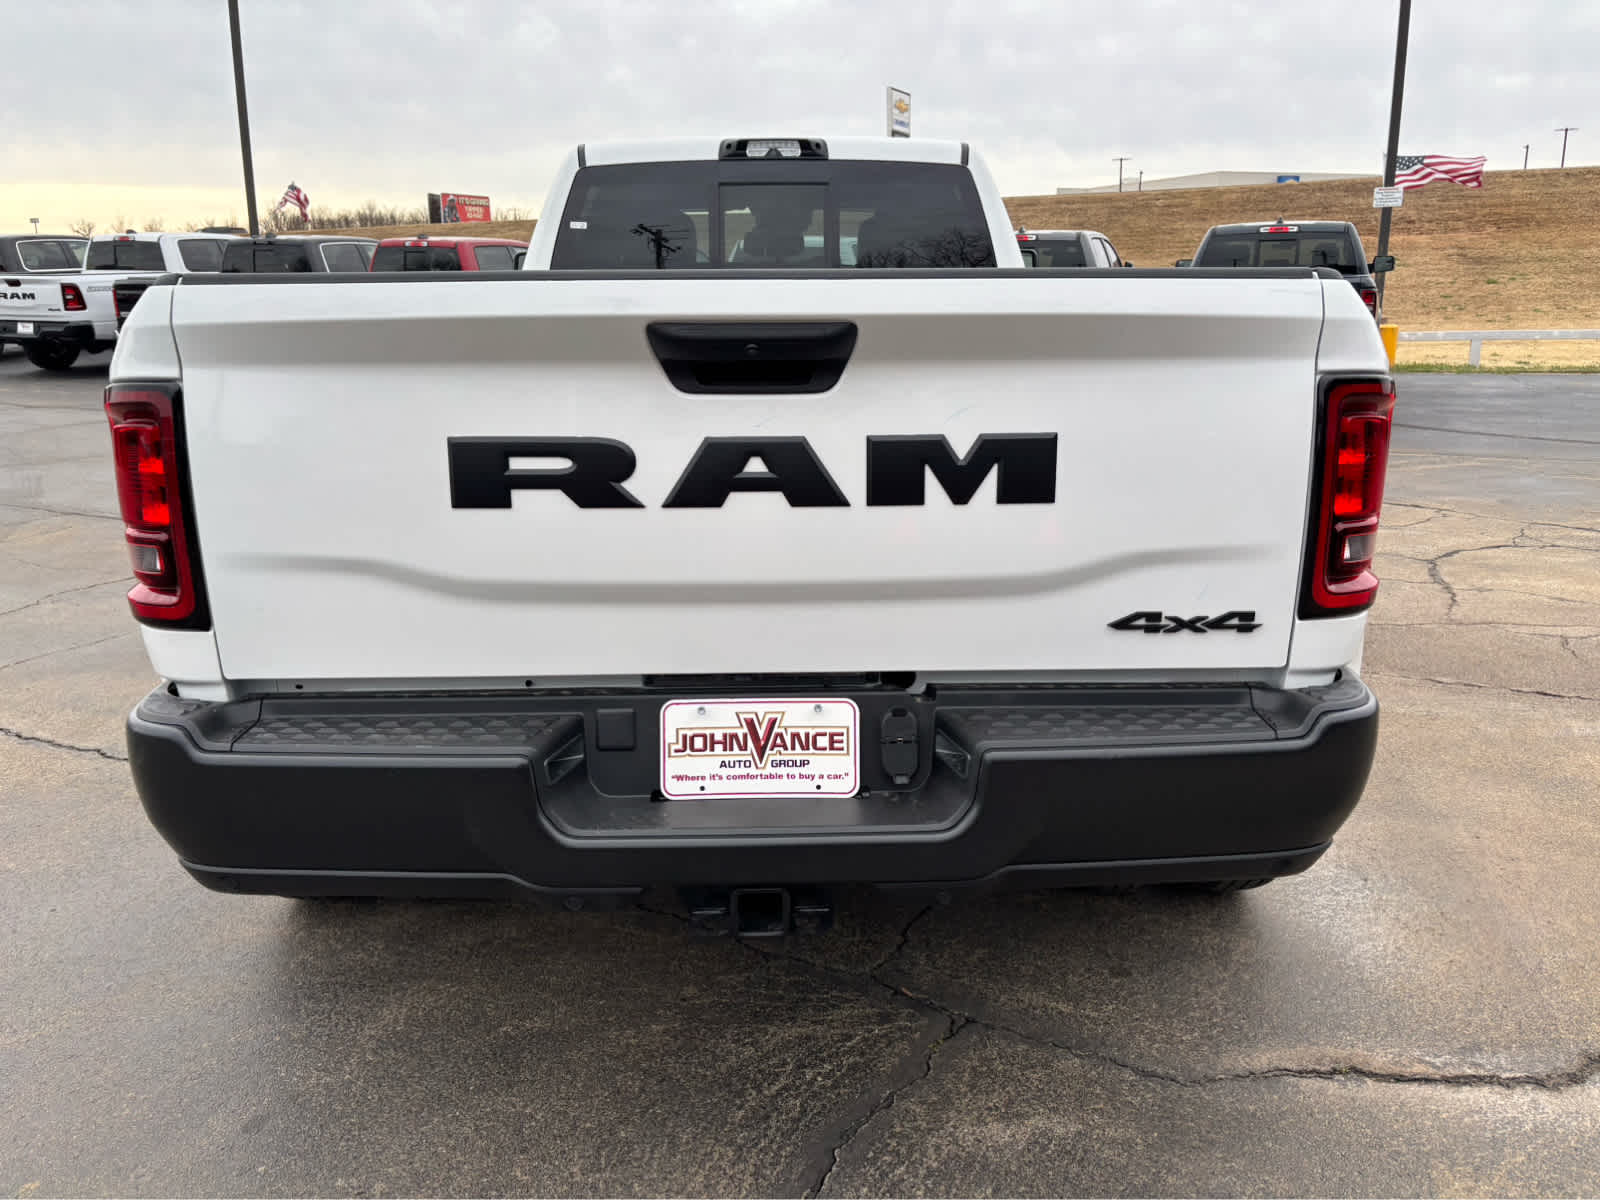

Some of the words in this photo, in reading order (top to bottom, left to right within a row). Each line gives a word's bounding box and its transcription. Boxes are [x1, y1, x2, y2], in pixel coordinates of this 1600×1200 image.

[0, 292, 36, 300] RAM
[447, 432, 1059, 509] RAM
[1107, 610, 1264, 634] 4x4
[673, 731, 748, 753] JOHN
[744, 717, 846, 765] VANCE
[719, 759, 752, 769] AUTO
[770, 759, 810, 768] GROUP
[671, 773, 706, 782] "Where
[709, 772, 723, 781] it's
[726, 772, 784, 781] comfortable
[786, 772, 796, 780] to
[798, 772, 815, 782] buy
[827, 772, 849, 780] car."
